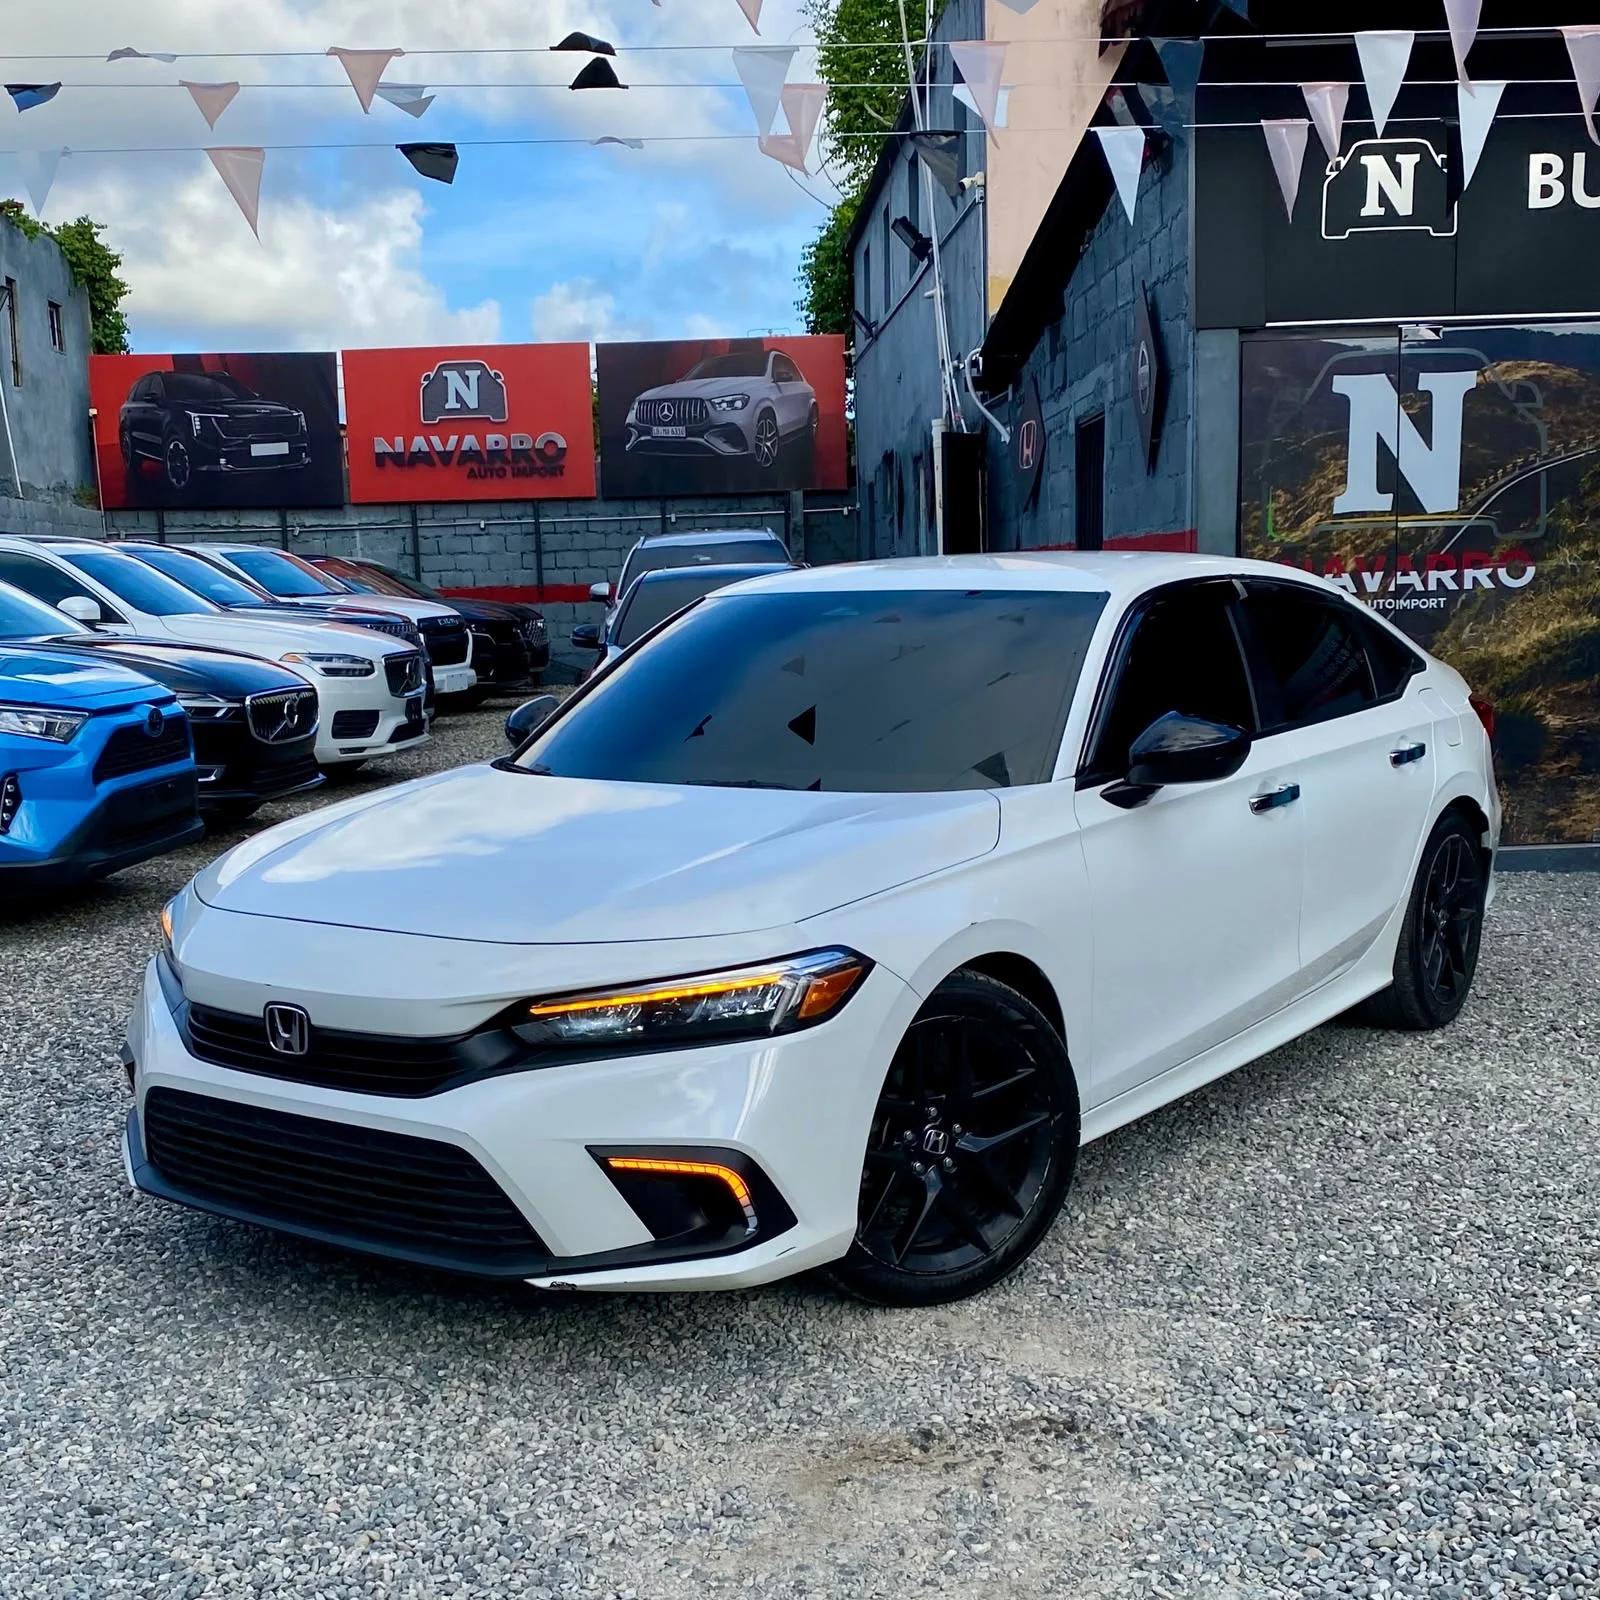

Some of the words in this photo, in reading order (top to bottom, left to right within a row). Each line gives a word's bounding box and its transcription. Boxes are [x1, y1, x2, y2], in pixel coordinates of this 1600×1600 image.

[1360, 153, 1420, 217] N
[443, 370, 480, 409] N
[374, 432, 567, 467] NAVARRO
[1332, 370, 1478, 514] N
[467, 467, 507, 479] AUTO
[511, 464, 565, 478] IMPORT
